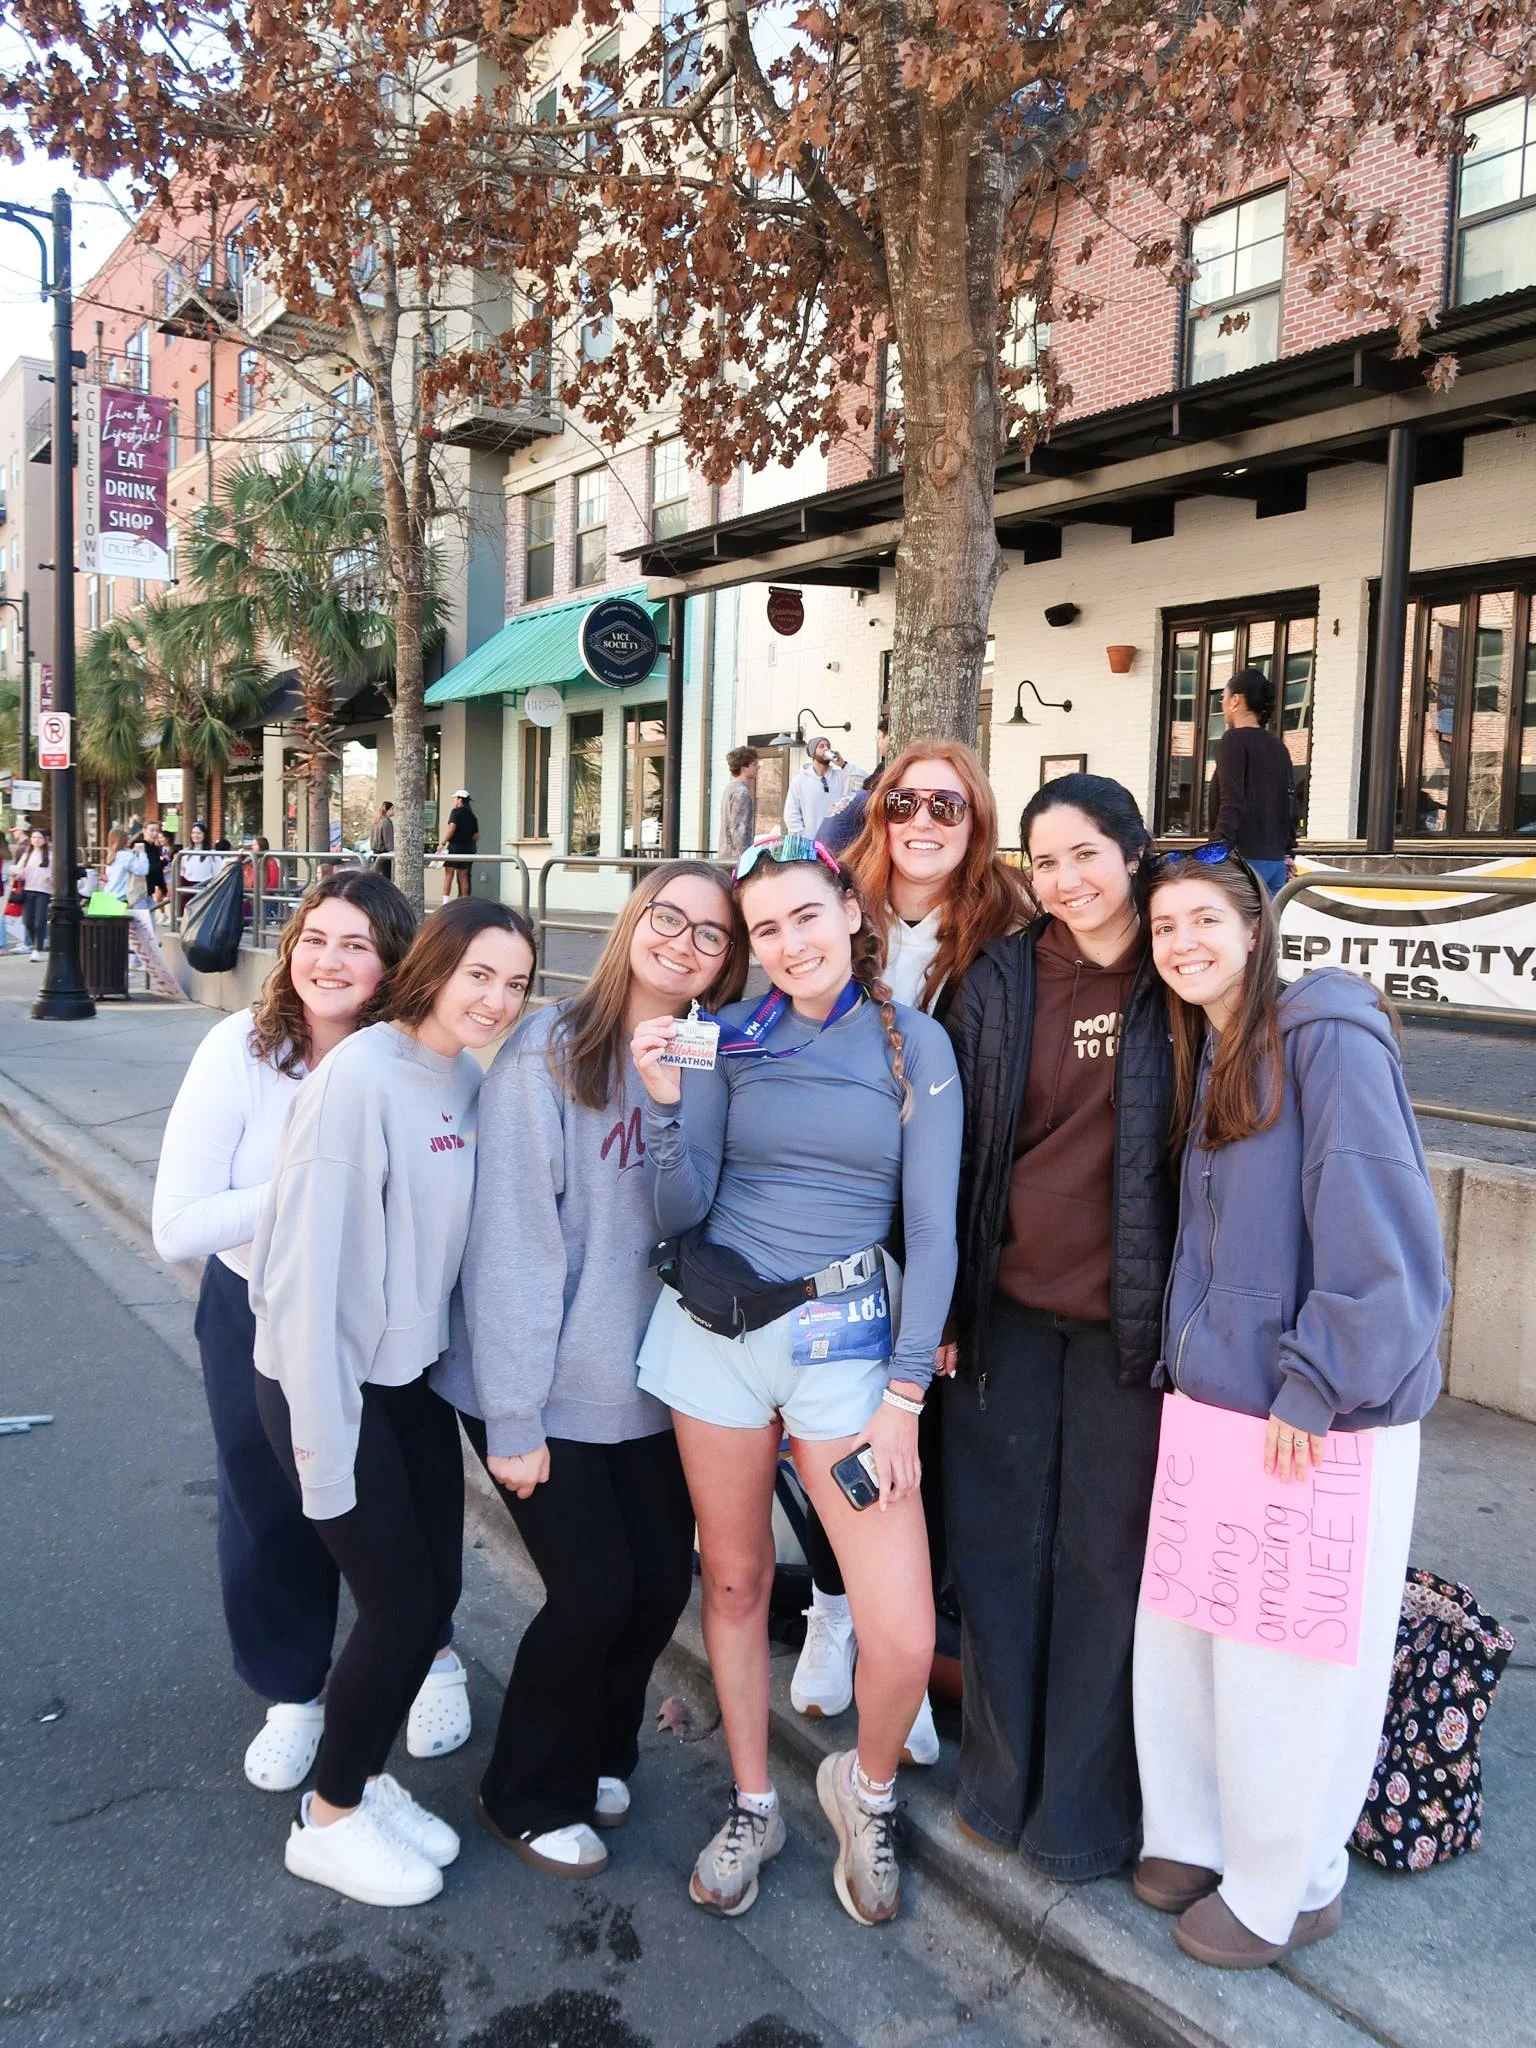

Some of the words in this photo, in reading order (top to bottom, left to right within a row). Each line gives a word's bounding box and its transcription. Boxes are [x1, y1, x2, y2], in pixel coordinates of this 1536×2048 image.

[105, 400, 135, 421] Live
[135, 400, 152, 423] the
[102, 420, 162, 451] Lifestyle!
[117, 450, 146, 469] EAT
[84, 391, 97, 568] COLLEGETOWN
[105, 479, 156, 501] DRINK
[109, 510, 154, 530] SHOP
[603, 640, 639, 650] SOCIETY
[612, 632, 631, 641] VICE
[1280, 934, 1331, 961] EP
[1341, 937, 1378, 966] IT
[1073, 1039, 1101, 1059] TO
[660, 1055, 714, 1068] MARATHON
[1293, 1435, 1362, 1648] SWEETIE
[1199, 1521, 1260, 1626] doing
[1256, 1504, 1310, 1642] amazing
